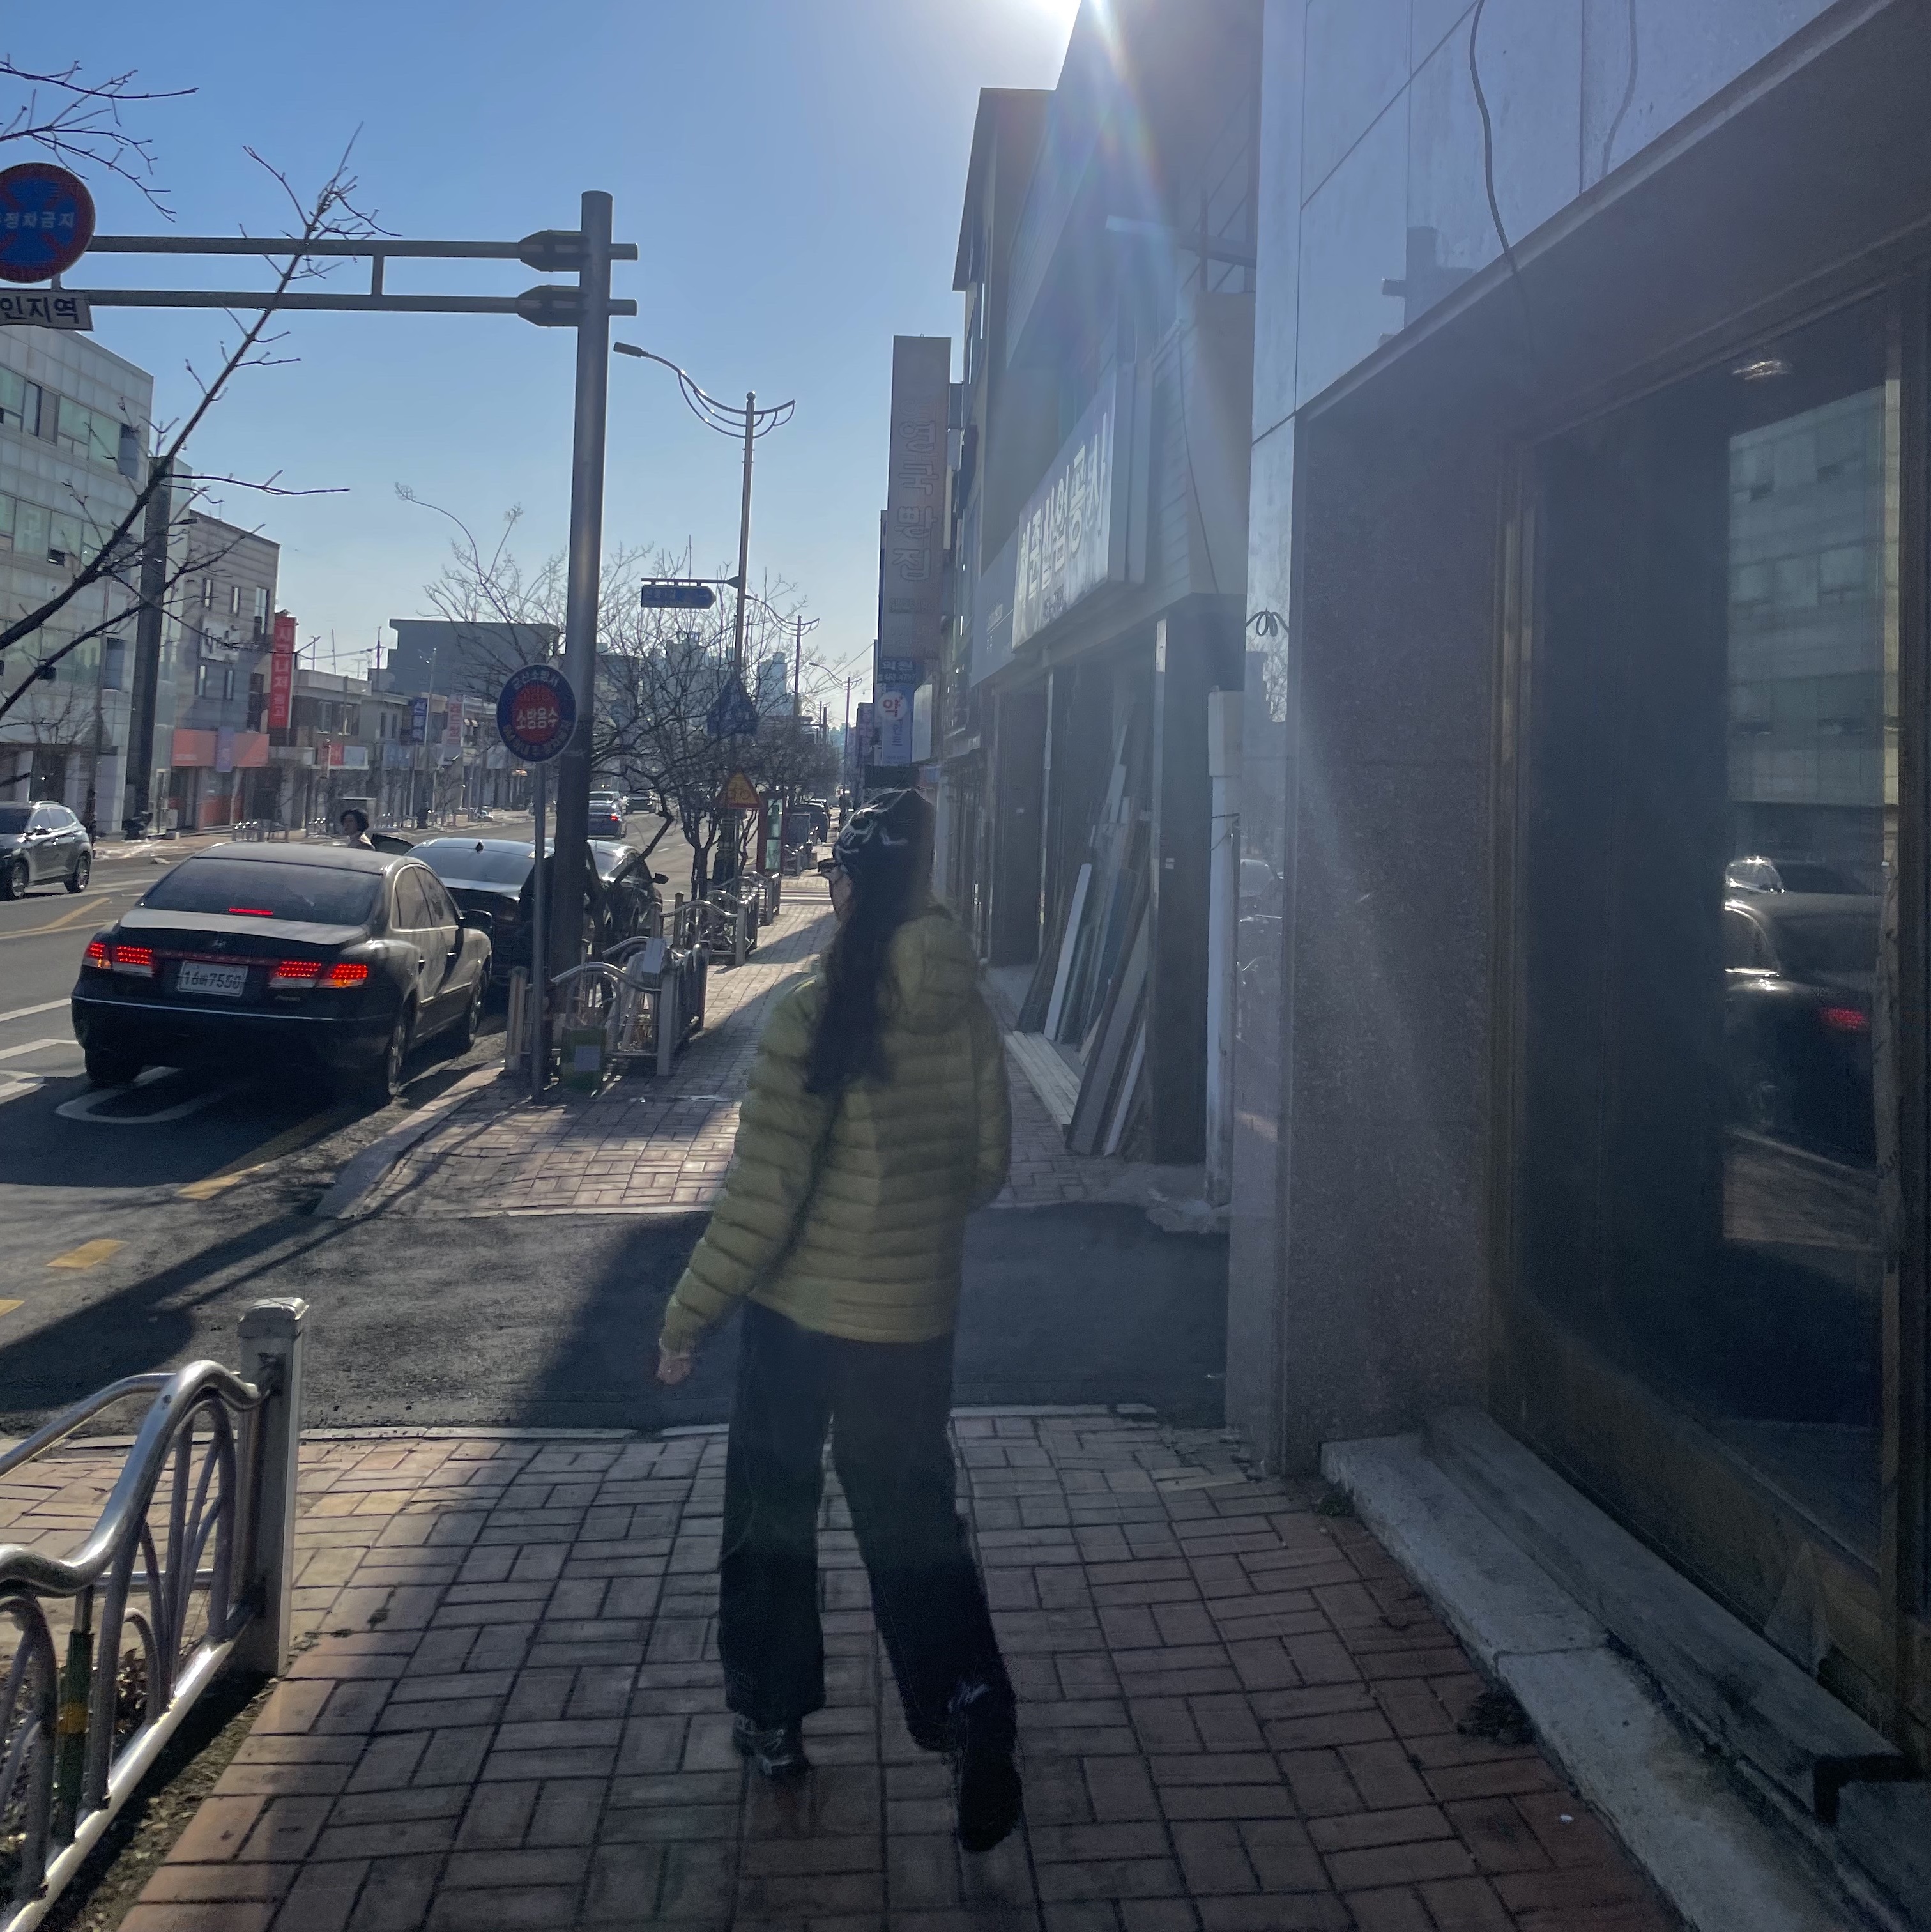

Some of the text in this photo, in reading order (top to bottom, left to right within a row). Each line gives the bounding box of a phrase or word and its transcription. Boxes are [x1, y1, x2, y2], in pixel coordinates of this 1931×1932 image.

[0, 211, 75, 229] 정차금지
[511, 670, 560, 690] 군산소방서
[516, 707, 558, 730] 소방용수
